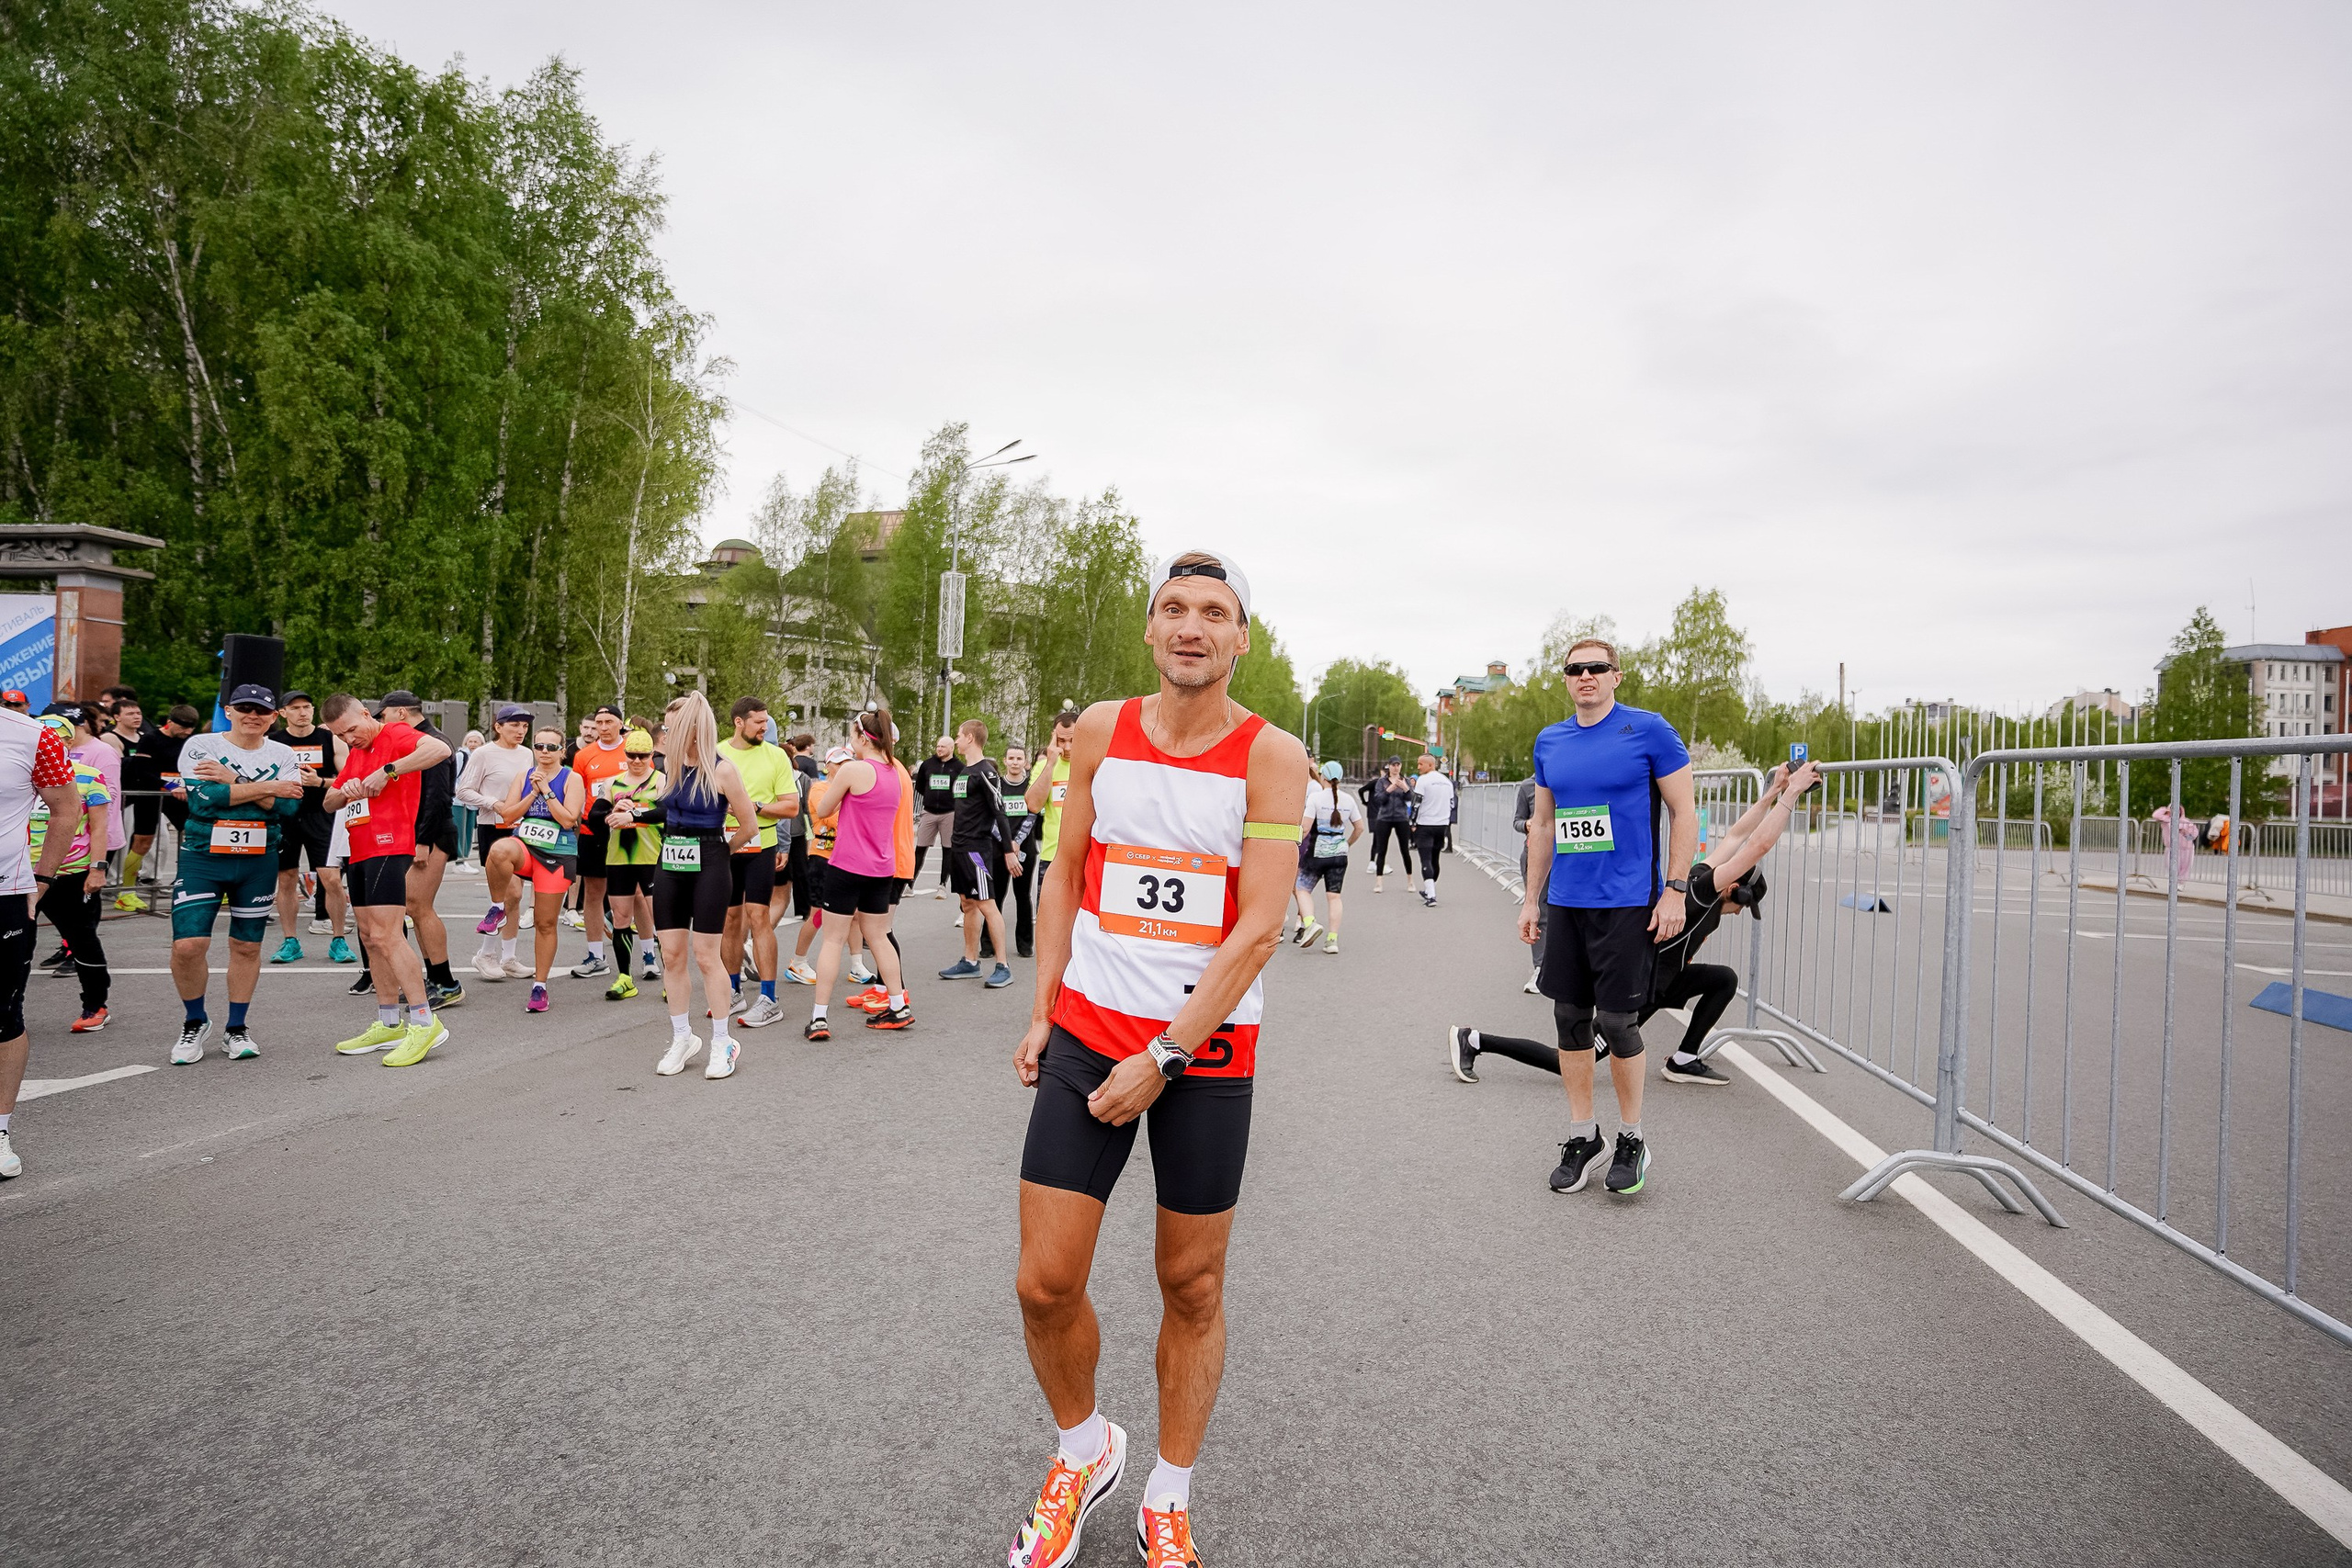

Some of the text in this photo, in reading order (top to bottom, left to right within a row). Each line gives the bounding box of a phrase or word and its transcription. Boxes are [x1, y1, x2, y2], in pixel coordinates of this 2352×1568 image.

[0, 633, 54, 676] ИЖЕНИЕ
[0, 653, 54, 693] РВЫХ
[1794, 746, 1804, 761] P
[230, 830, 250, 844] 31
[524, 825, 554, 840] 1549
[1560, 819, 1605, 839] 1586
[665, 847, 695, 862] 1144
[1136, 874, 1185, 913] 33
